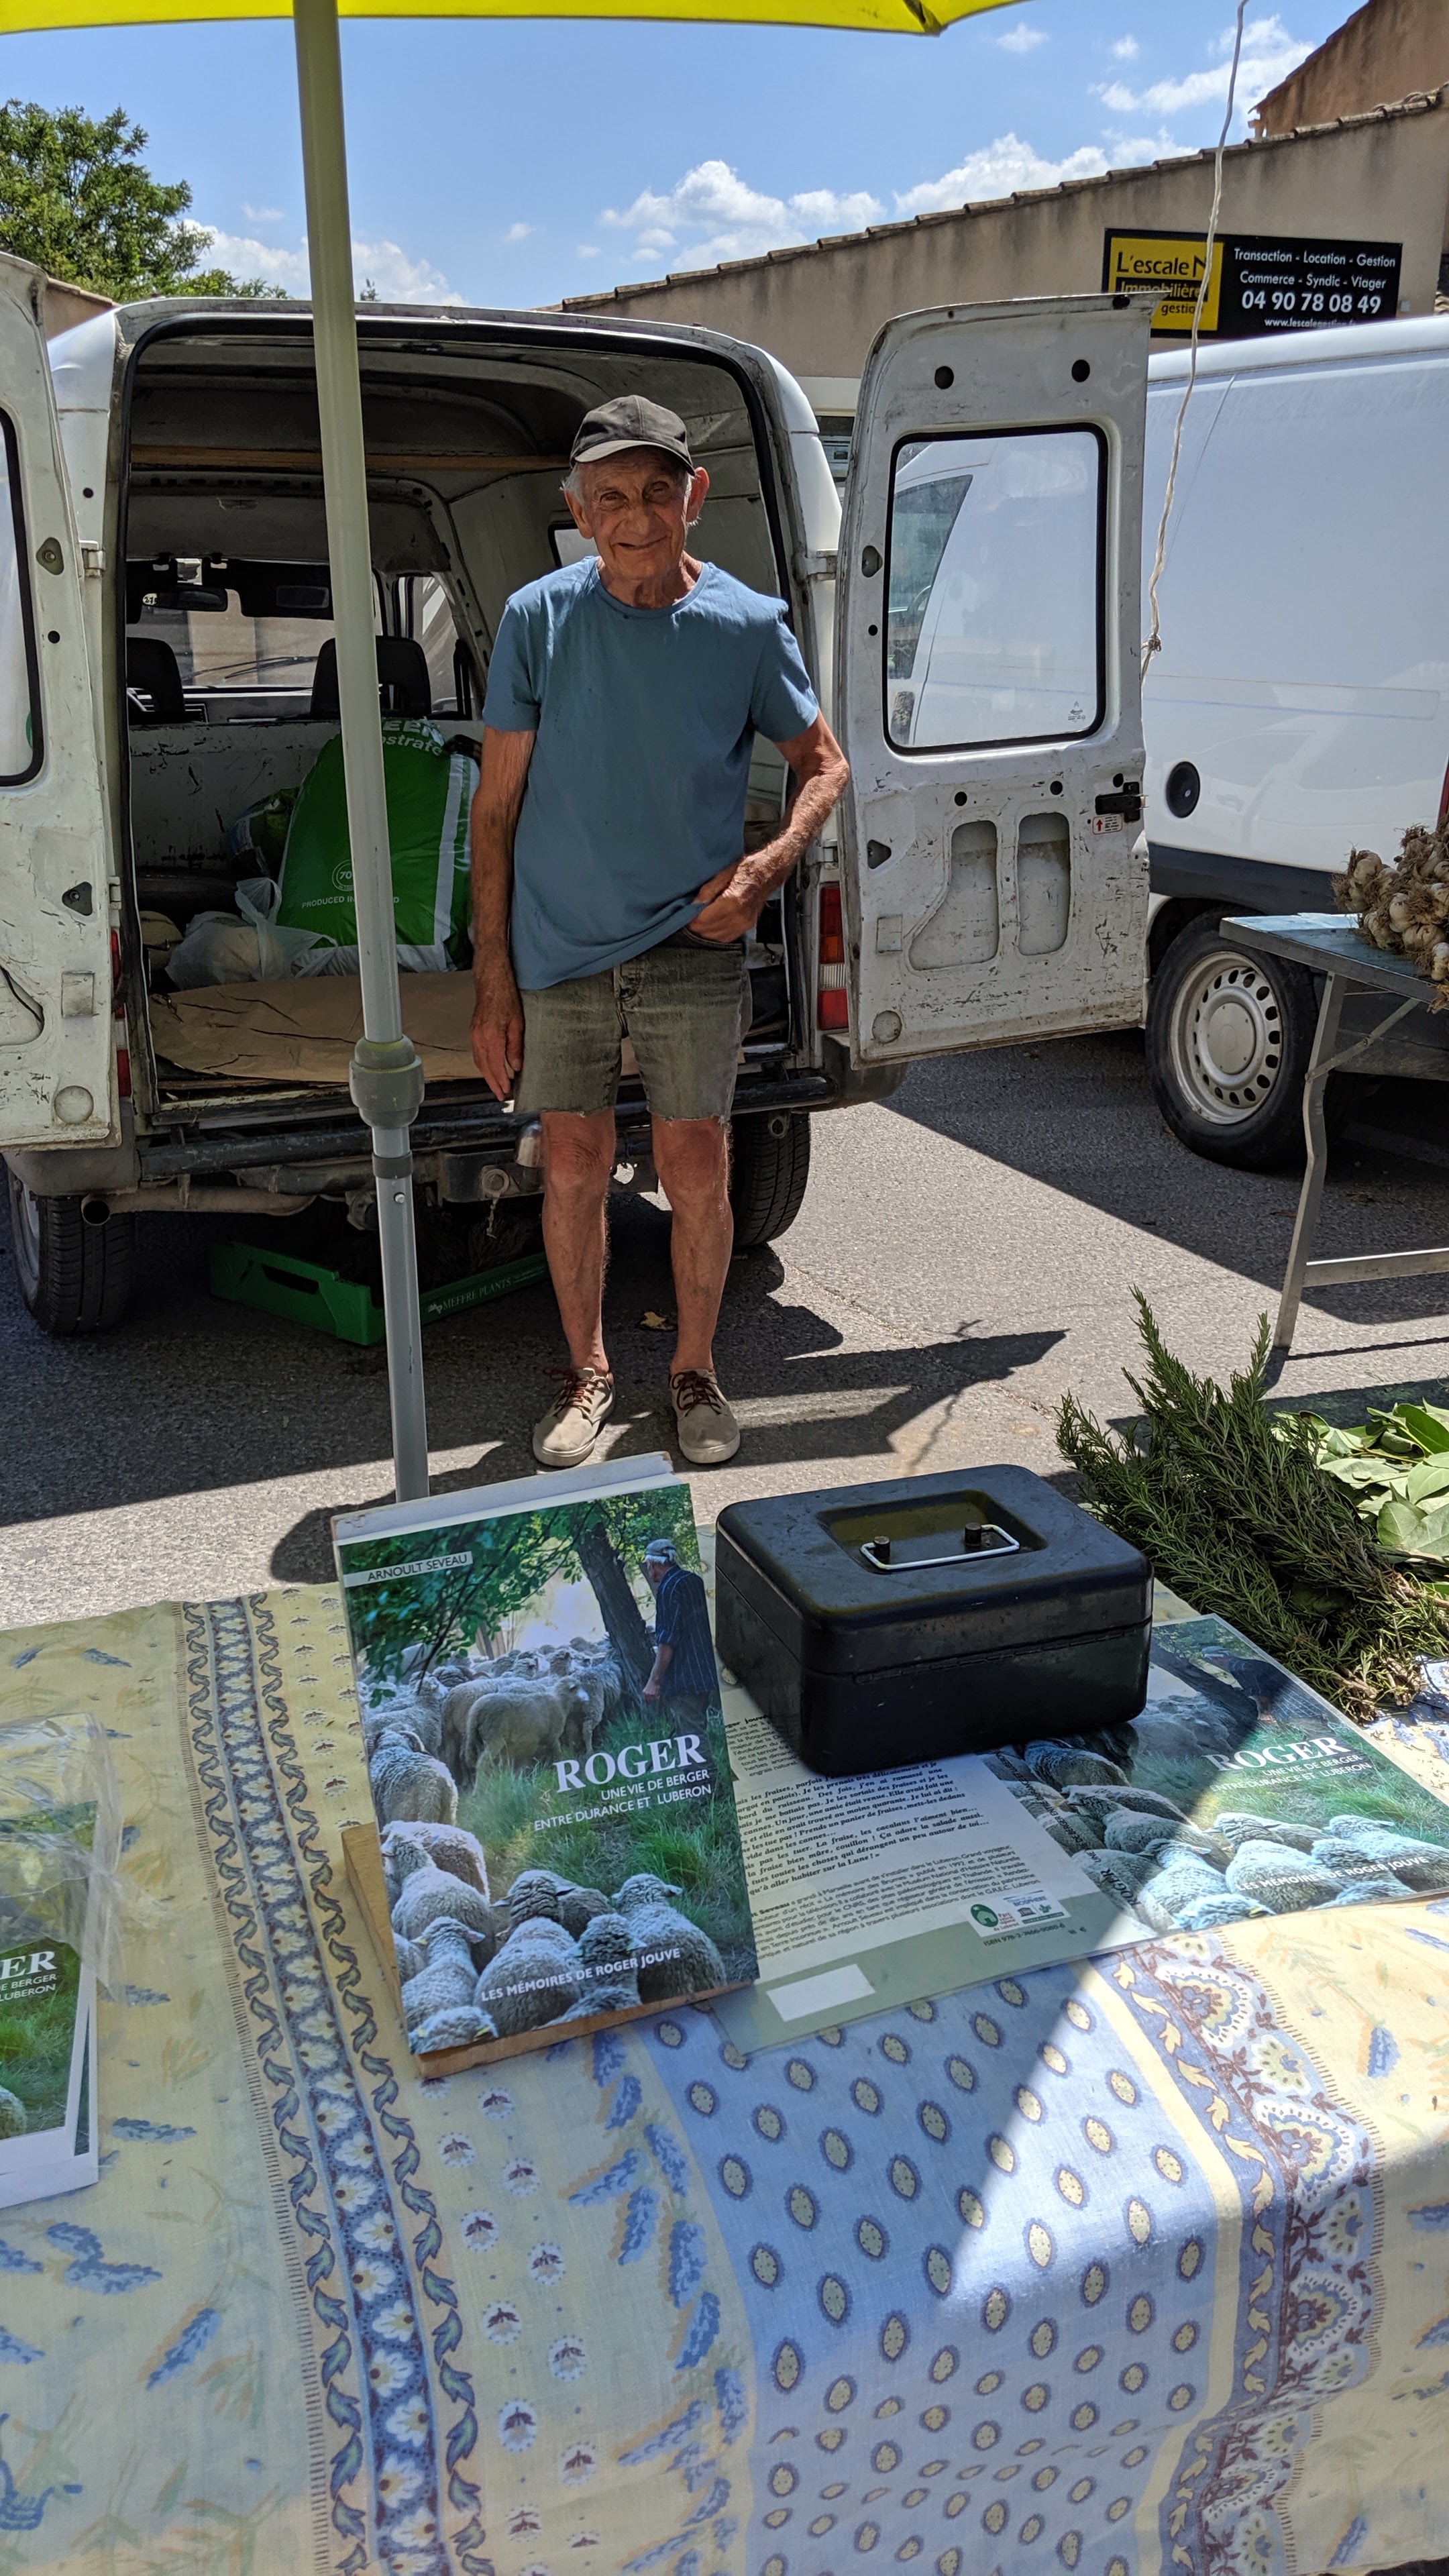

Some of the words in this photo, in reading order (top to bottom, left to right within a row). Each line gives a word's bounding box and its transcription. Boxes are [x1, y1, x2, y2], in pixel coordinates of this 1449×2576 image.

[1116, 252, 1190, 275] L'escale
[1234, 248, 1293, 262] Transaction
[1303, 250, 1346, 265] Location
[1356, 253, 1396, 268] Gestion
[1240, 270, 1295, 285] Commerce
[1305, 272, 1341, 289] Syndic
[1350, 275, 1387, 292] Viager
[1161, 303, 1203, 316] gestio
[1241, 290, 1267, 310] 04
[1271, 292, 1296, 311] 90
[1301, 293, 1324, 312] 78
[1328, 294, 1353, 313] 08
[1356, 295, 1382, 314] 49
[382, 734, 443, 757] strate
[302, 896, 345, 908] PRODUCED
[443, 1290, 477, 1309] MEFFRE
[479, 1277, 512, 1296] PLANTS
[368, 1562, 425, 1582] ARNOULT
[426, 1554, 468, 1570] SEVEAU
[553, 1734, 706, 1793] ROGER
[1202, 1737, 1351, 1772] ROGER
[1263, 1769, 1287, 1777] UNE
[1287, 1765, 1305, 1773] VIE
[1305, 1762, 1322, 1770] DE
[1322, 1755, 1362, 1768] BERGER
[601, 1789, 625, 1801] UNE
[626, 1782, 645, 1795] VIE
[648, 1779, 664, 1791] DE
[666, 1769, 710, 1788] BERGER
[1210, 1781, 1247, 1792] ENTRE
[1247, 1776, 1303, 1788] DURANCE
[1320, 1763, 1373, 1777] LUBERON
[534, 1813, 573, 1831] ENTRE
[576, 1800, 635, 1822] DURANCE
[637, 1796, 651, 1809] ET
[657, 1784, 712, 1805] LUBERON
[1098, 1868, 1142, 1906] ROGER
[1236, 1881, 1259, 1892] LES
[1260, 1871, 1326, 1887] MÉMOIRES
[1328, 1869, 1345, 1879] DE
[1346, 1863, 1388, 1876] ROGER
[1389, 1856, 1429, 1870] JOUVE
[0, 1951, 57, 1980] ER
[481, 1987, 503, 2002] LES
[506, 1972, 574, 1996] MÉMOIRES
[576, 1968, 593, 1980] DE
[595, 1957, 639, 1977] ROGER
[641, 1948, 681, 1969] JOUVE
[0, 1983, 8, 1991] E
[11, 1974, 57, 1989] BERGER
